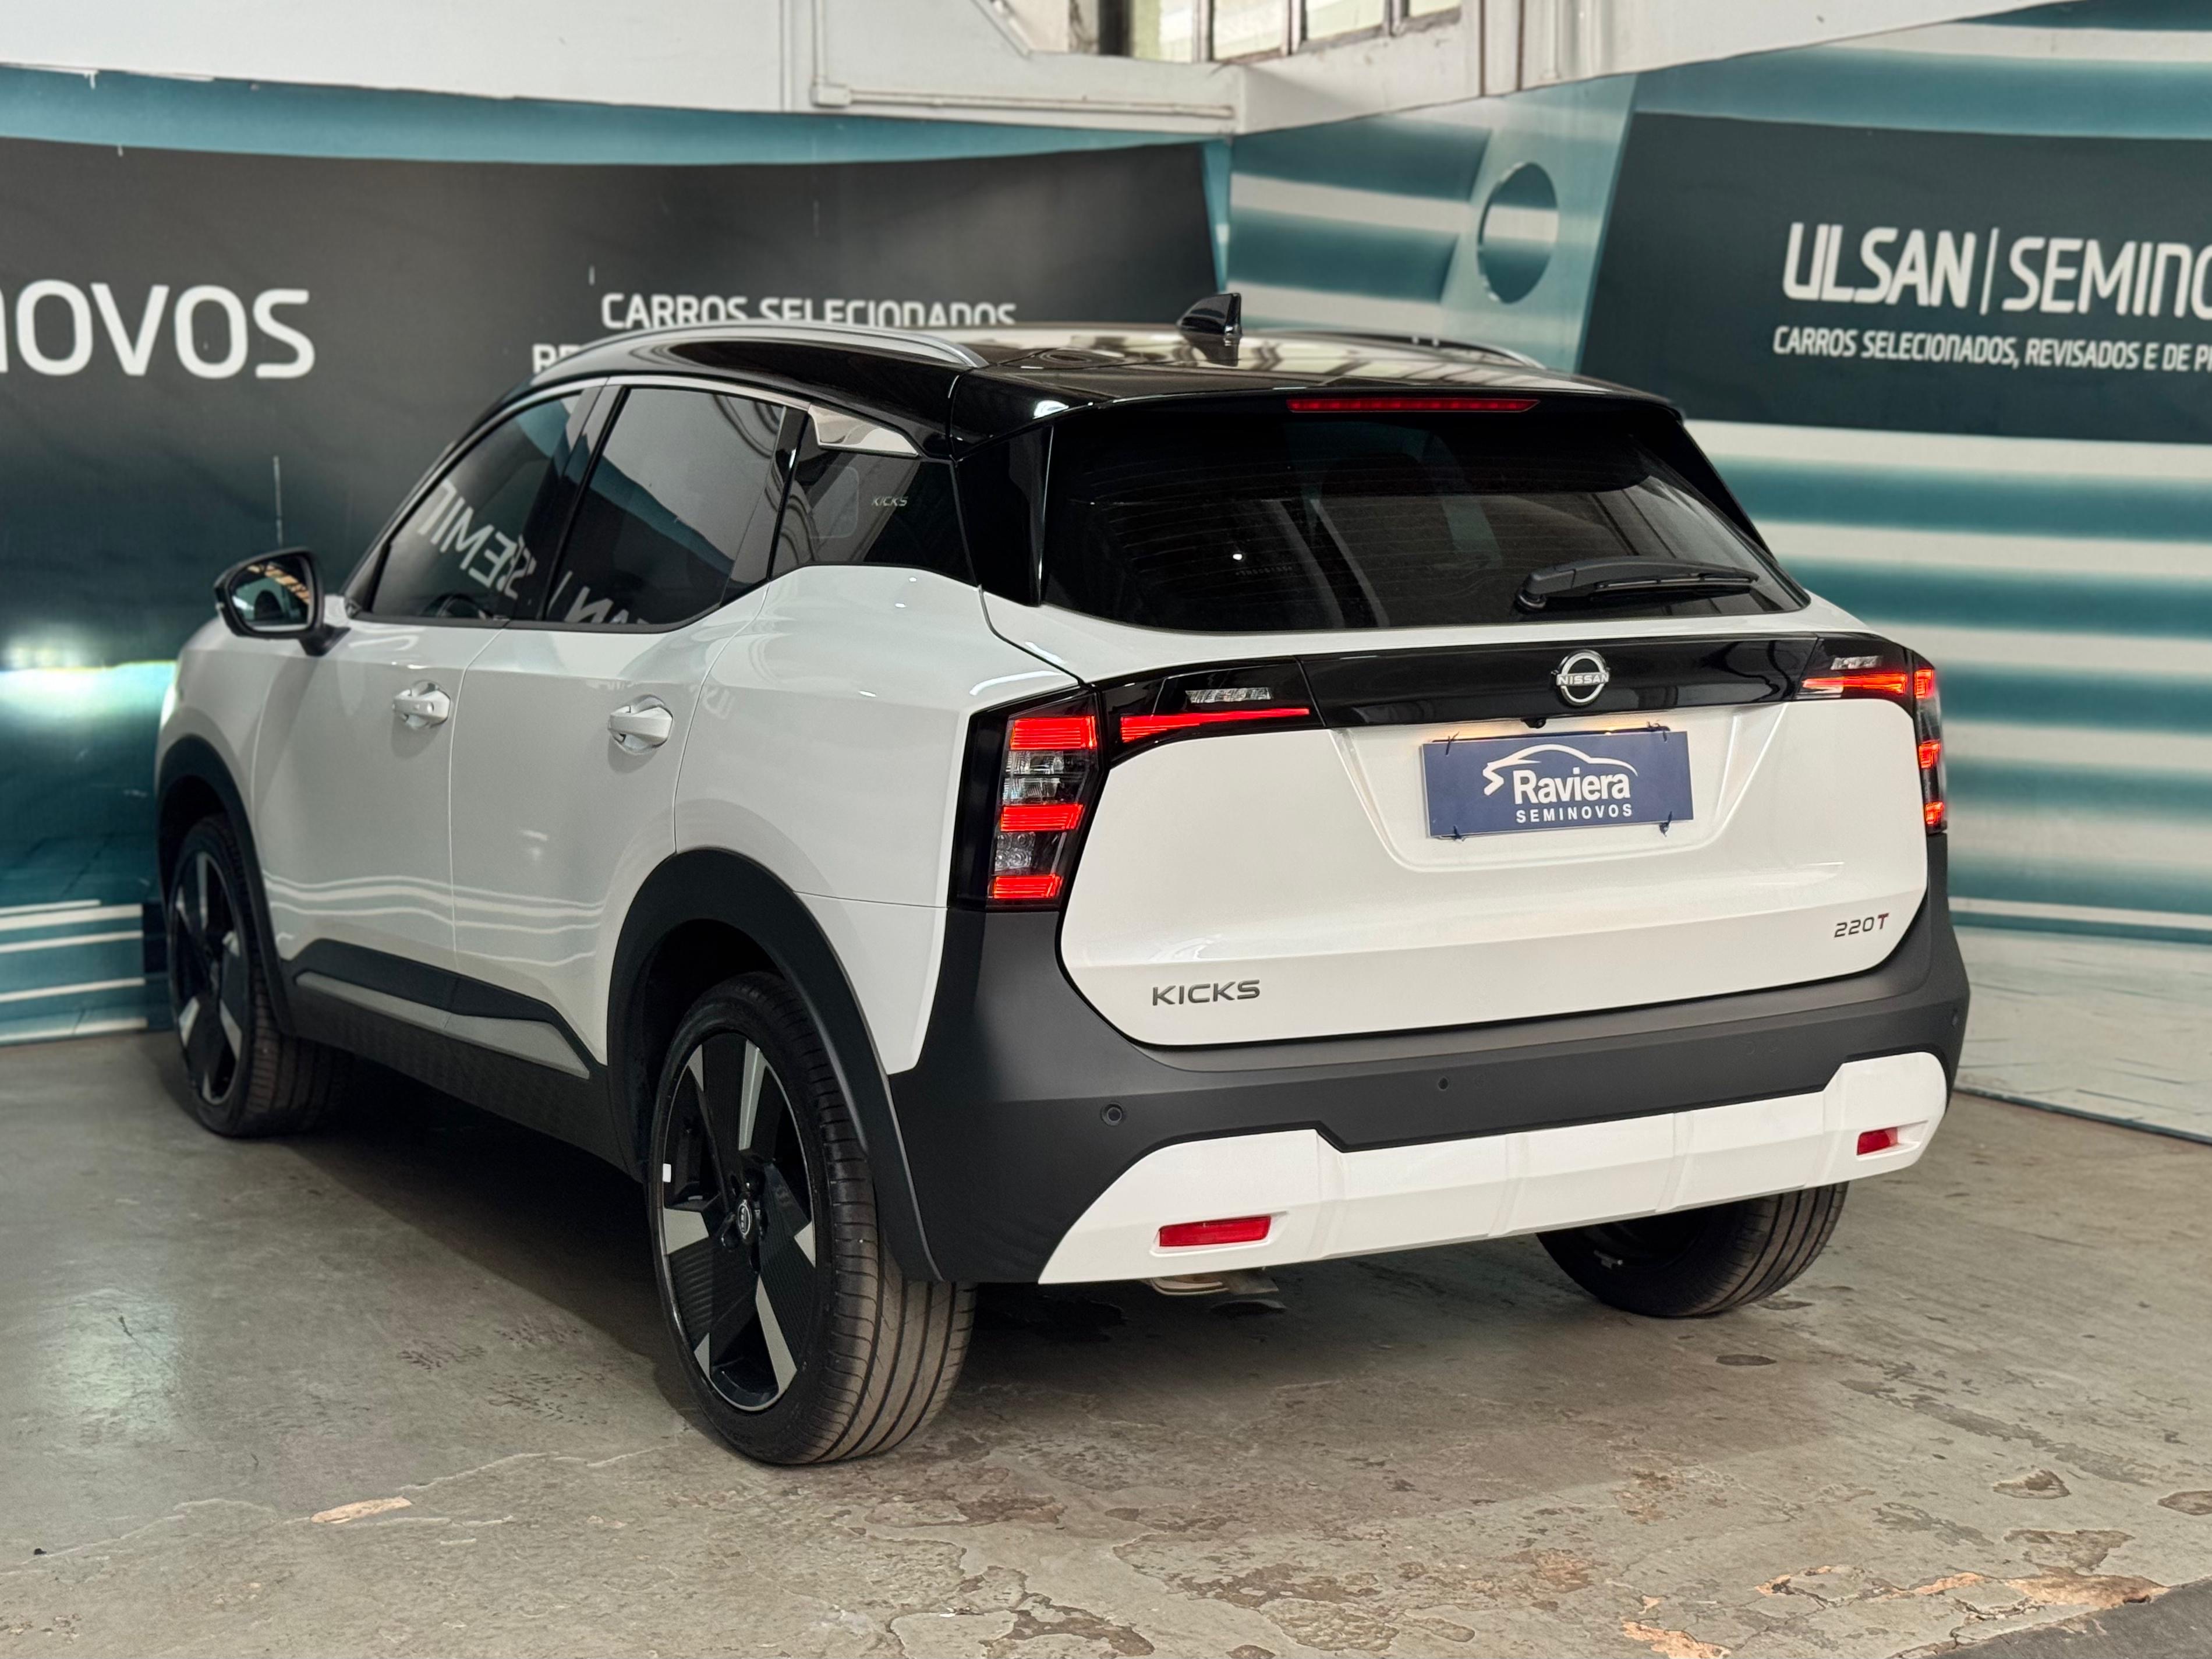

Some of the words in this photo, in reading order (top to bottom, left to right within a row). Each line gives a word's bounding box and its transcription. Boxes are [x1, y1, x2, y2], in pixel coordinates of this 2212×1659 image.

[1783, 222, 1976, 308] ULSAN
[601, 293, 748, 330] CARROS
[0, 280, 315, 379] OVOS
[1773, 326, 1859, 358] CARROS
[1860, 329, 2020, 369] SELECIONADOS,
[2025, 338, 2141, 370] REVISADOS
[2143, 342, 2160, 370] E
[2161, 343, 2192, 372] DE
[2194, 344, 2212, 373] P
[871, 495, 909, 507] KICKS
[1557, 674, 1609, 685] NISSAN
[1513, 766, 1630, 804] Raviera
[1516, 803, 1632, 823] SEMINOVOS
[1834, 912, 1890, 938] 220T
[1152, 979, 1261, 1006] KICKS
